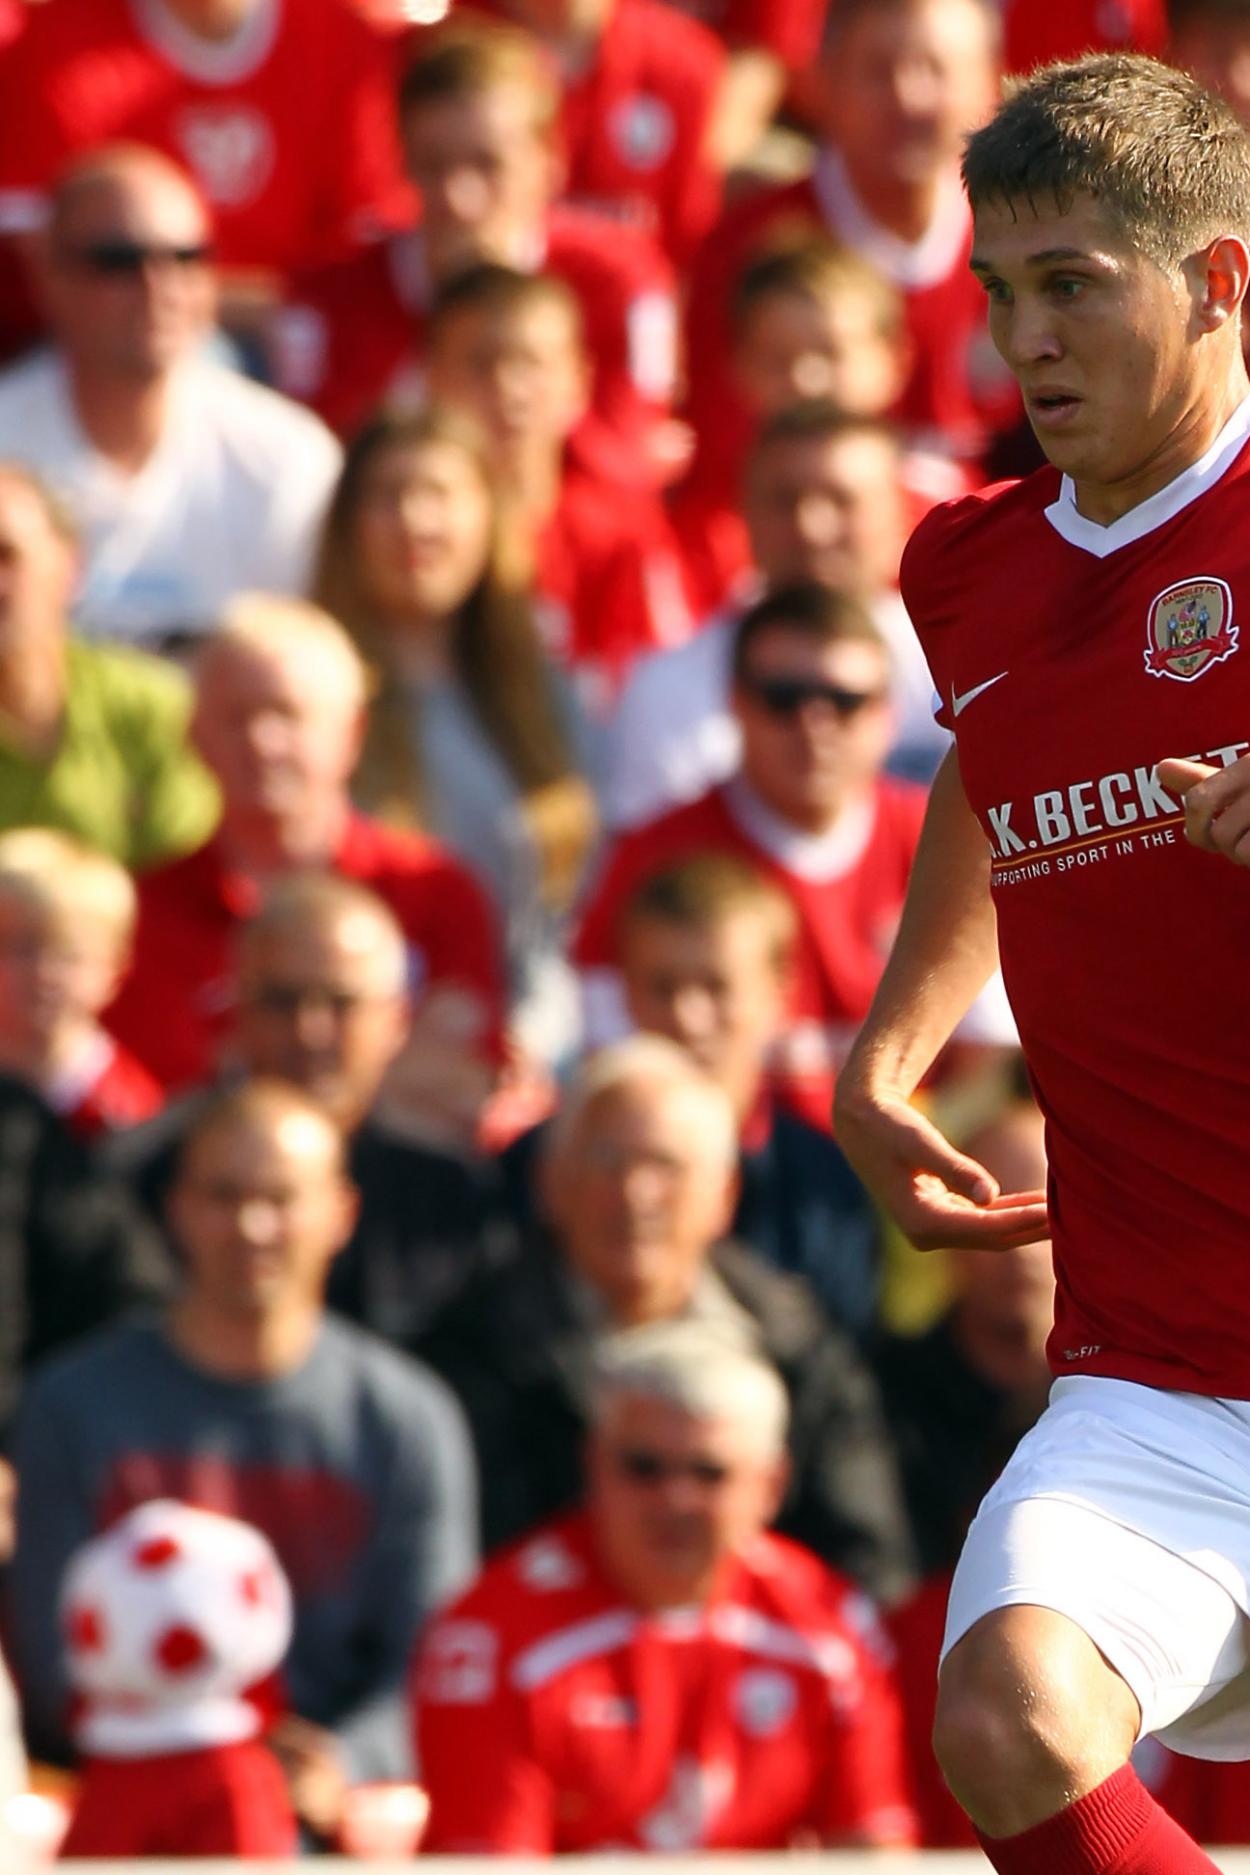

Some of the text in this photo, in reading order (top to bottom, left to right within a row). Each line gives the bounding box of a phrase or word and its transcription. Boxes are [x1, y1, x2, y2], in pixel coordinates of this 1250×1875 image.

[1056, 845, 1109, 872] SPORT
[1116, 839, 1134, 857] IN
[1140, 829, 1176, 850] THE
